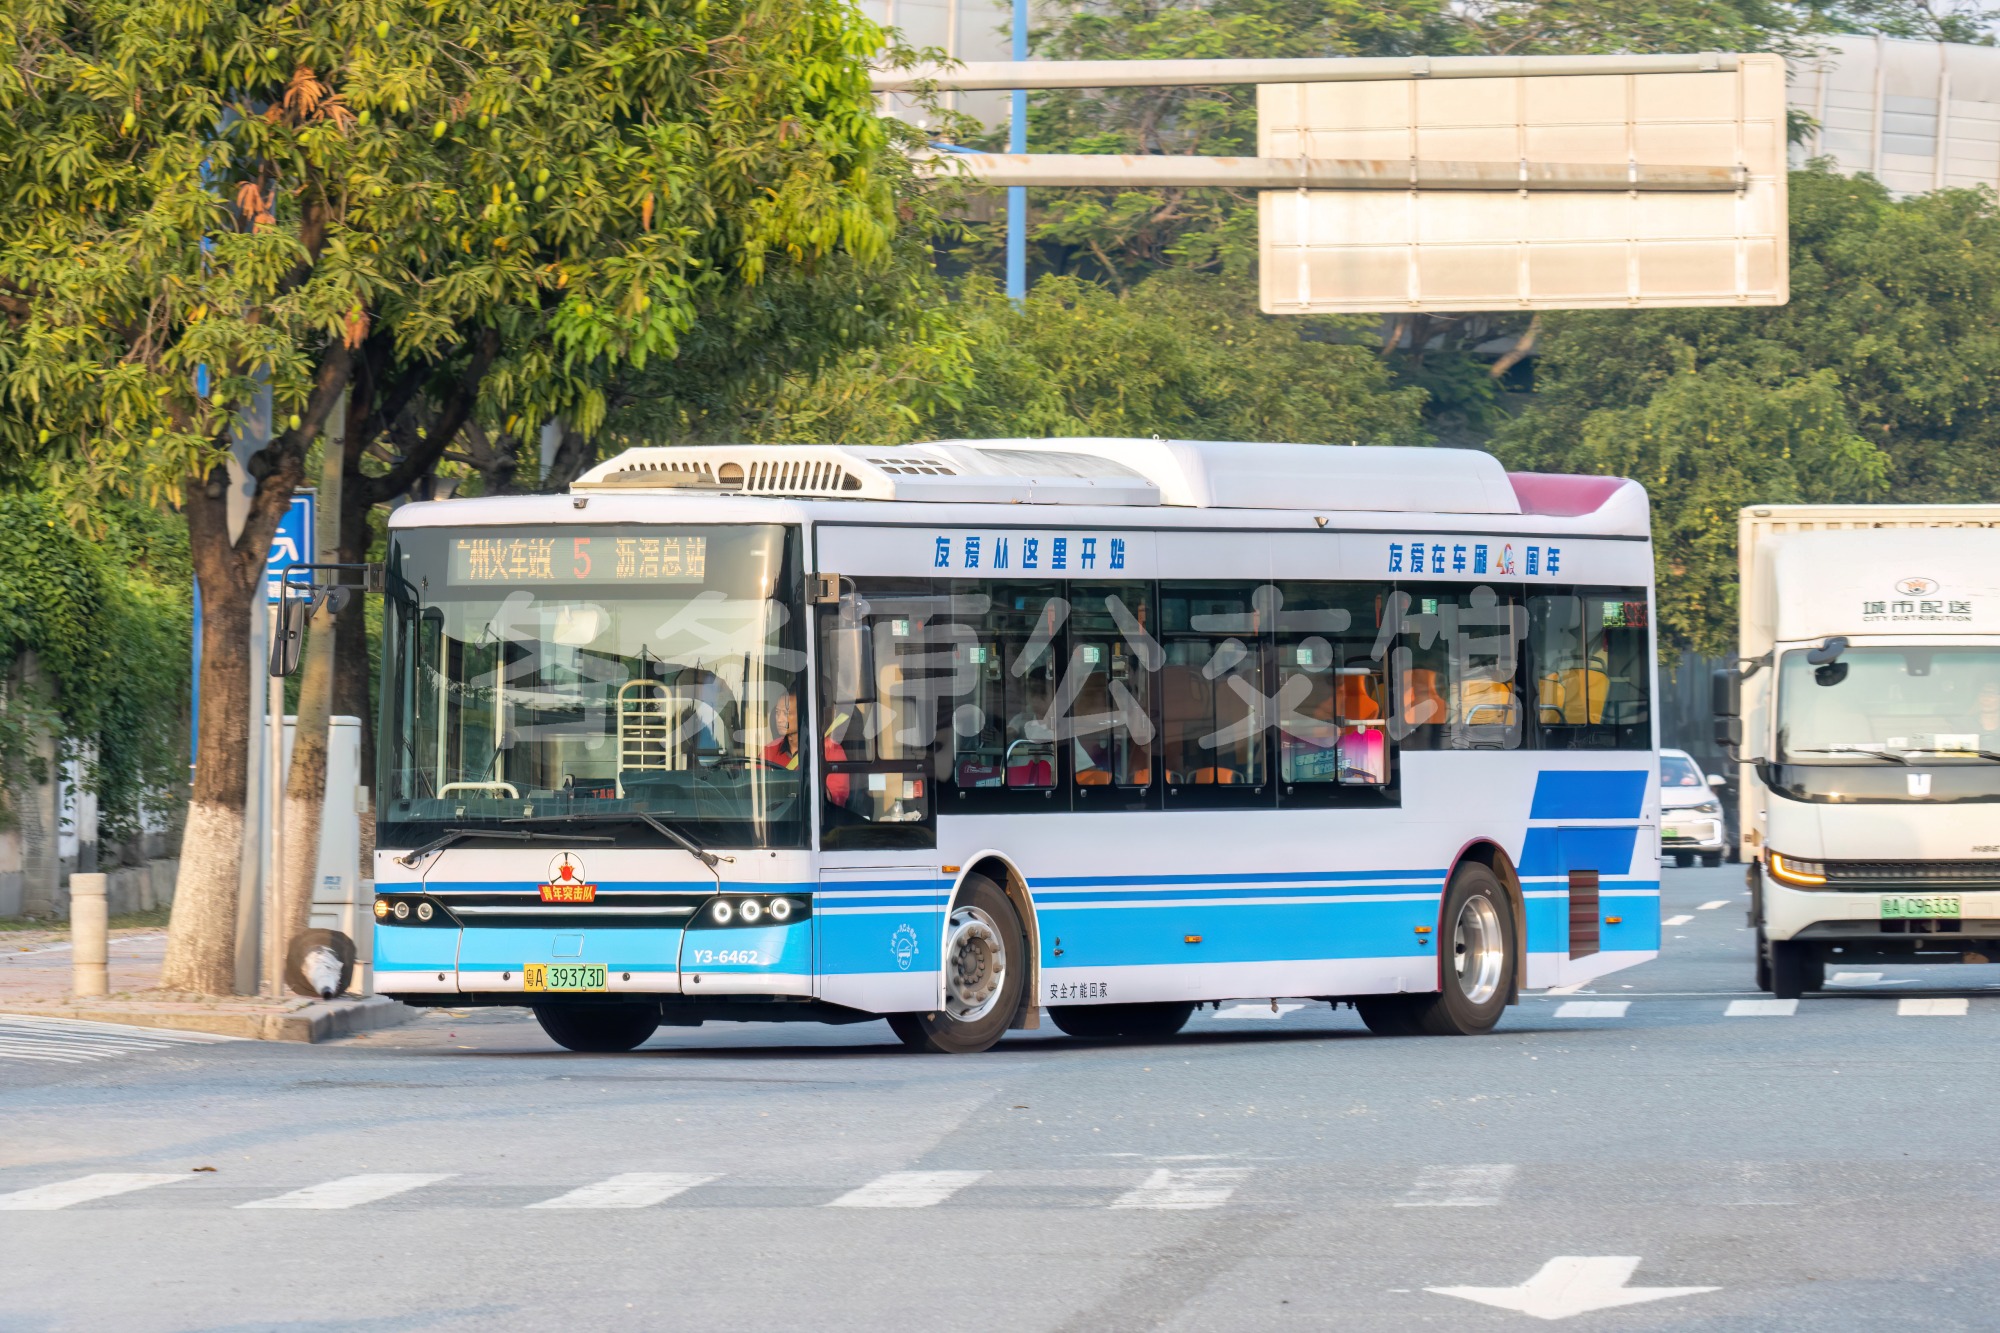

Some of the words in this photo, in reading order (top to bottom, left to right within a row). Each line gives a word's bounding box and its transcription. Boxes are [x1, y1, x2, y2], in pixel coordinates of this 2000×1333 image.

[573, 537, 592, 579] 5
[934, 536, 1126, 569] 友爱从这里开始
[1862, 600, 1972, 614] 城市配送
[541, 885, 593, 901] 青年突击队
[693, 949, 759, 964] Y3-6462
[1050, 982, 1108, 999] 安全才能回家
